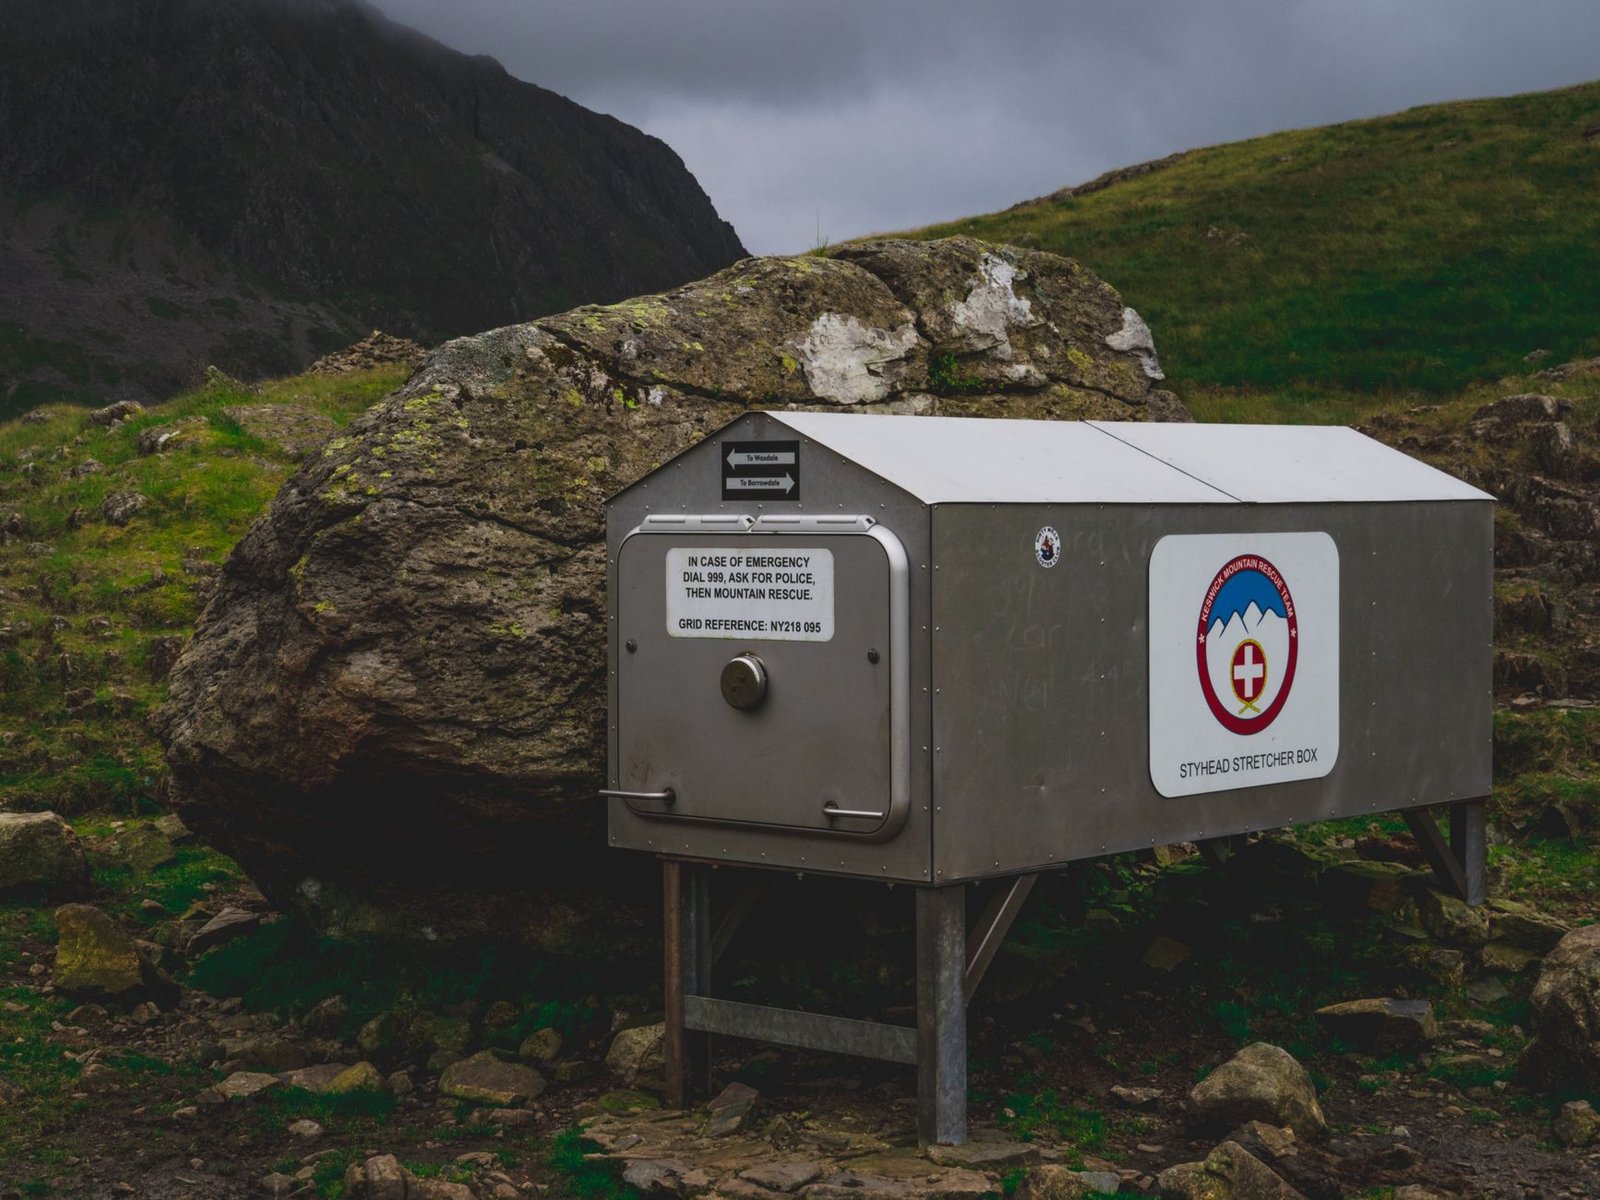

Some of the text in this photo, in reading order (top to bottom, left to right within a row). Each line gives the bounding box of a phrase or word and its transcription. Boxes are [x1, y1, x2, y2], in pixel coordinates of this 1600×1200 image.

[746, 454, 779, 462] To Wasdale
[740, 479, 780, 487] To Borrowdale
[688, 556, 810, 568] IN CASE OF EMERGENCY
[683, 571, 816, 586] DIAL 999, ASK FOR POLICE,
[685, 587, 813, 601] THEN MOUNTAIN RESCUE.
[1201, 558, 1294, 622] KESWICK MOUNTAIN RESCUE TEAM
[678, 618, 822, 633] GRID REFERENCE: NY218 095
[1179, 747, 1318, 779] STYHEAD STRETCHER BOX
